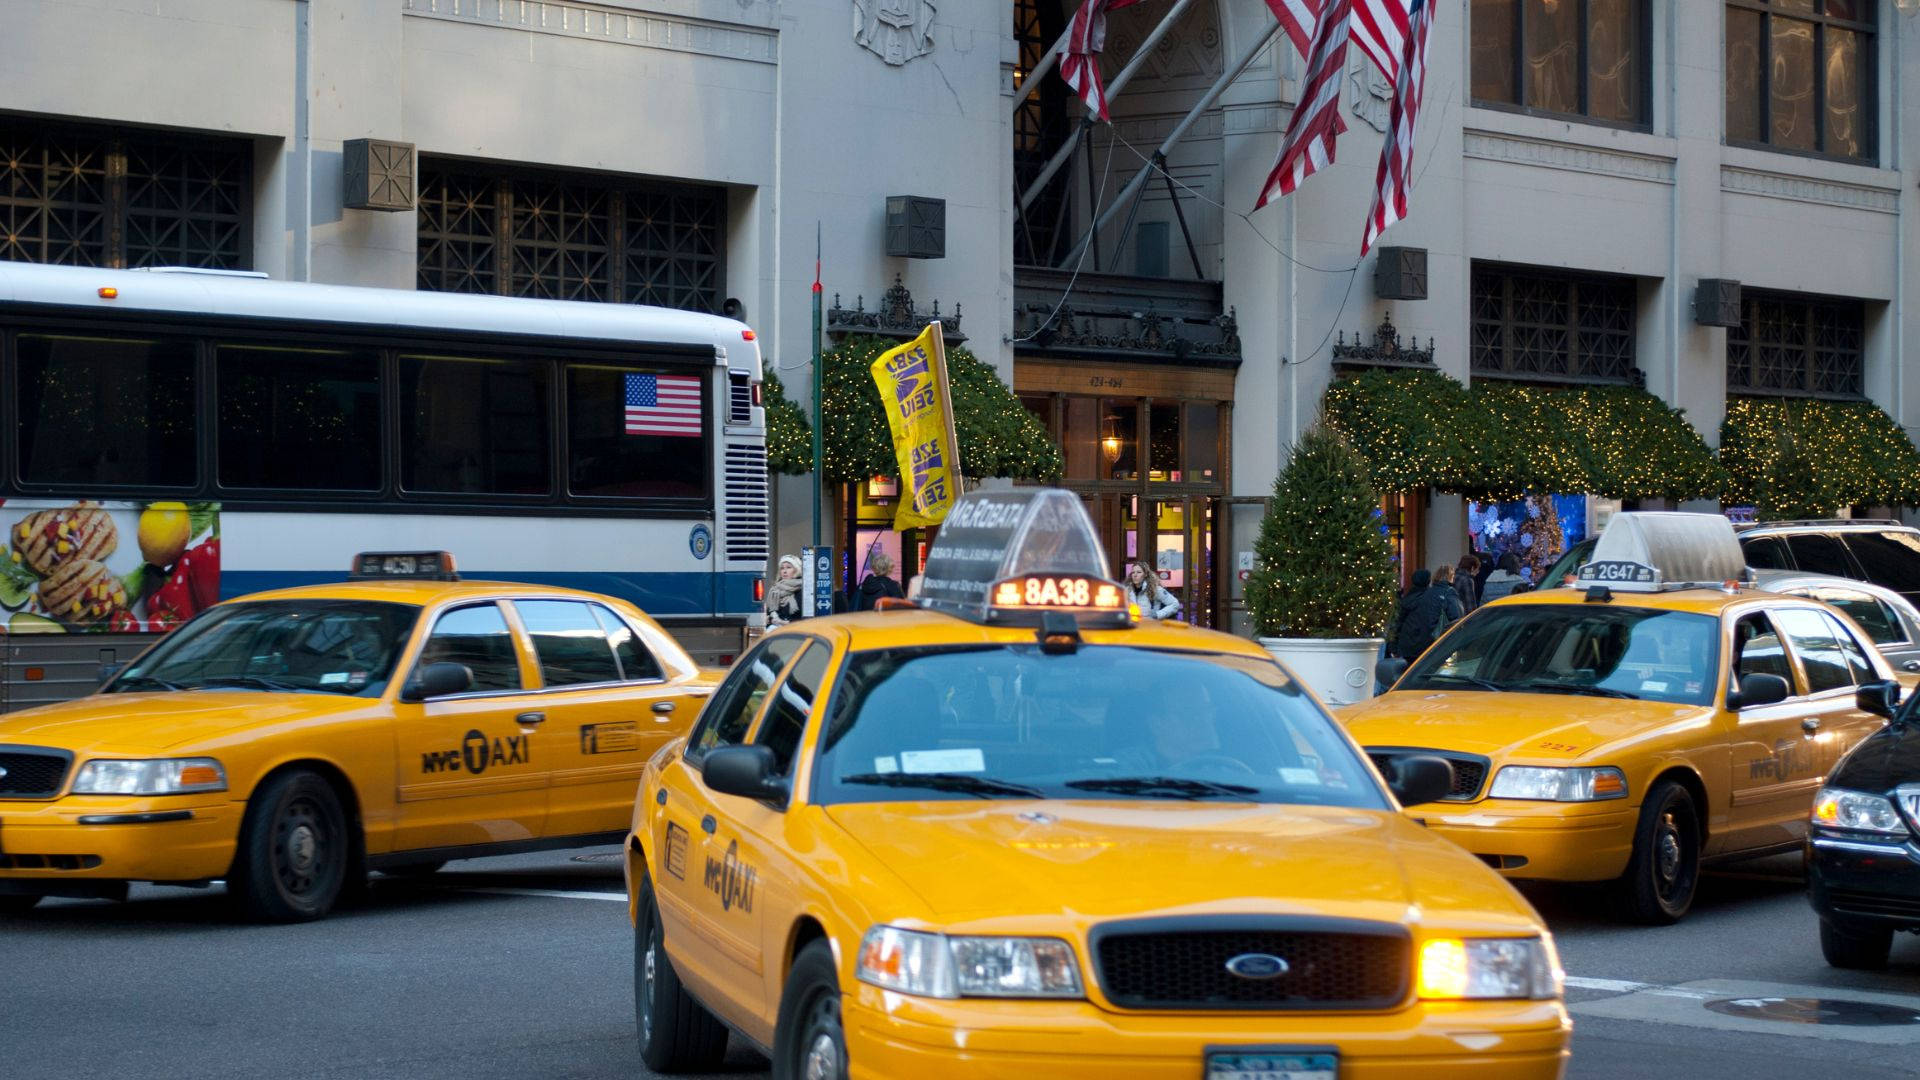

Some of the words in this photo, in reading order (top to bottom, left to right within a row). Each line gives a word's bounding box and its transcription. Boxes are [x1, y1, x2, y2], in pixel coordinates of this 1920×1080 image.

[818, 572, 830, 580] BUS
[1598, 564, 1635, 579] 2G47
[816, 580, 831, 588] STOP
[1025, 578, 1090, 605] 8A38
[421, 750, 461, 774] NYC
[463, 729, 530, 774] TAXI
[704, 854, 722, 895] NYC
[722, 838, 757, 914] TAXI
